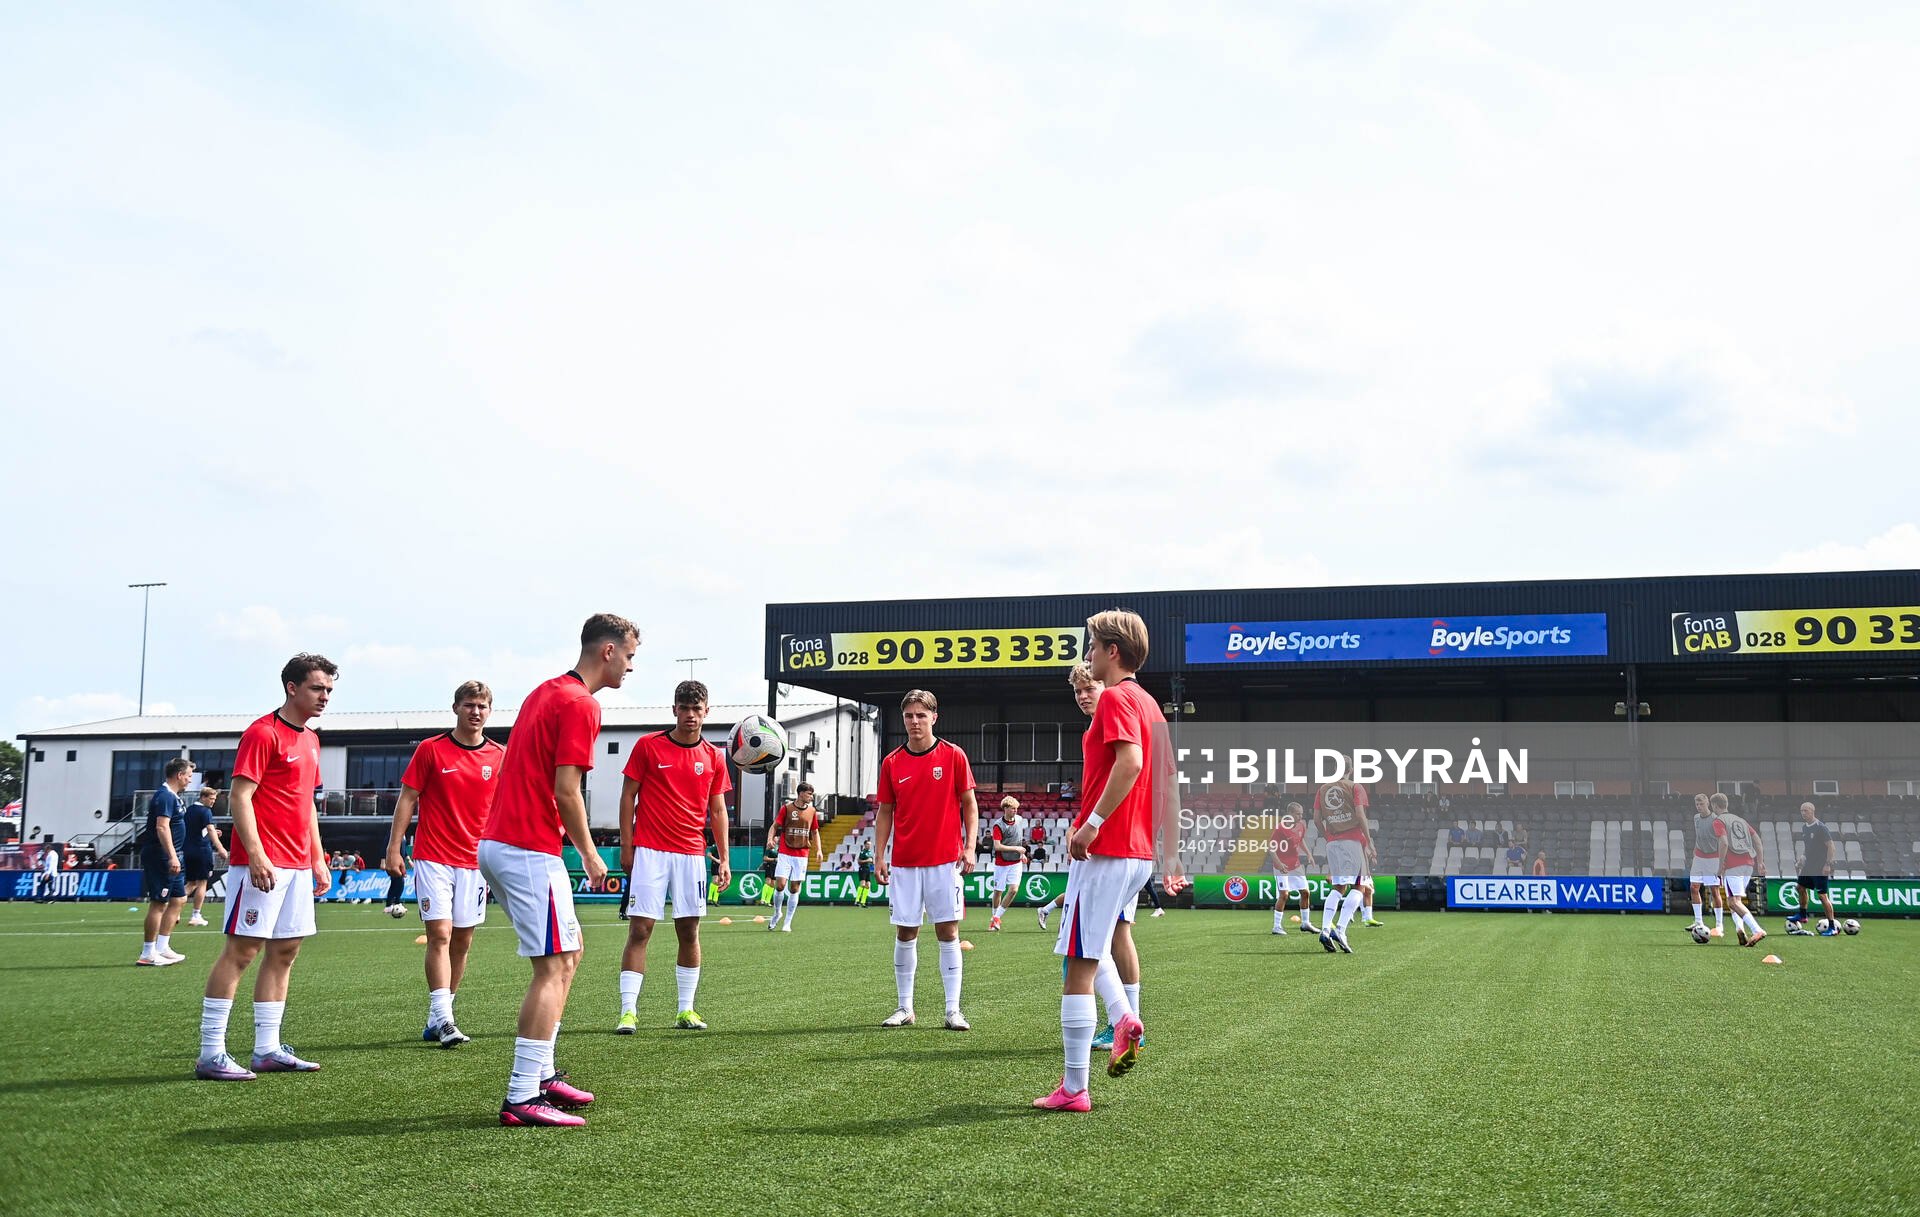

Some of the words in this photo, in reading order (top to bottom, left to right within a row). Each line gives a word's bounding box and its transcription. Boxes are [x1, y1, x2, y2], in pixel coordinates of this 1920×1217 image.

[1684, 617, 1726, 633] fona
[1745, 632, 1786, 647] 028
[1794, 616, 1857, 646] 90
[789, 638, 823, 652] fona
[1227, 631, 1360, 655] BoyleSports
[1431, 625, 1571, 651] BoyleSports
[1684, 631, 1732, 652] CAB
[789, 651, 828, 670] CAB
[837, 652, 869, 666] 028
[876, 638, 924, 664] 90
[933, 636, 1000, 663] 333
[1010, 635, 1078, 661] 333
[1460, 883, 1552, 903] CLEARER
[1560, 883, 1637, 903] WATER
